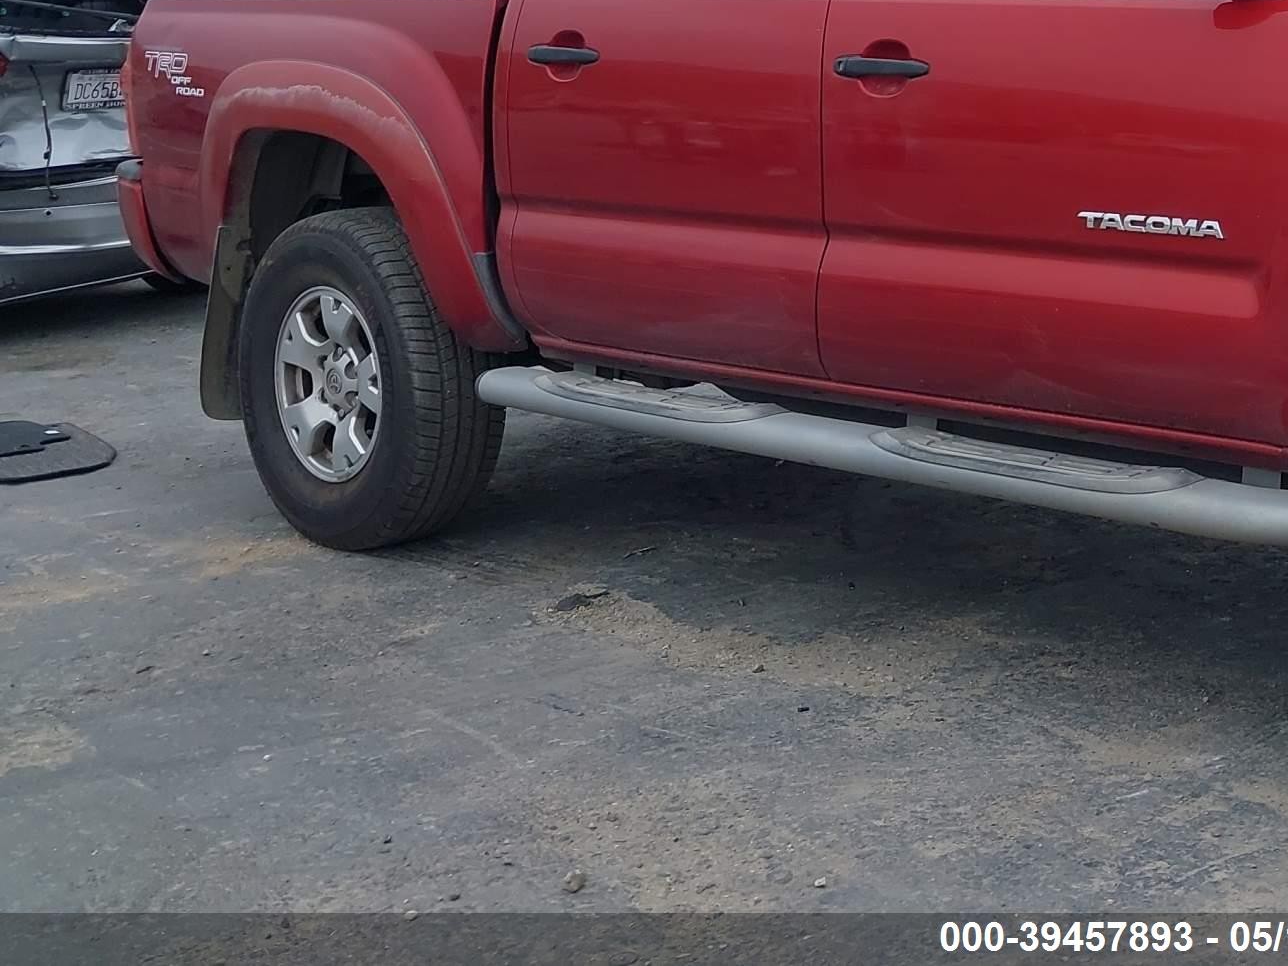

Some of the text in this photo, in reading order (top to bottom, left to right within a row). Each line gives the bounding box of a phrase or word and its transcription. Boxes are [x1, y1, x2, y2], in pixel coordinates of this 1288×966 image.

[145, 51, 188, 79] TRD
[171, 76, 192, 85] OFF
[176, 87, 205, 97] ROAD
[1077, 211, 1224, 239] TACOMA
